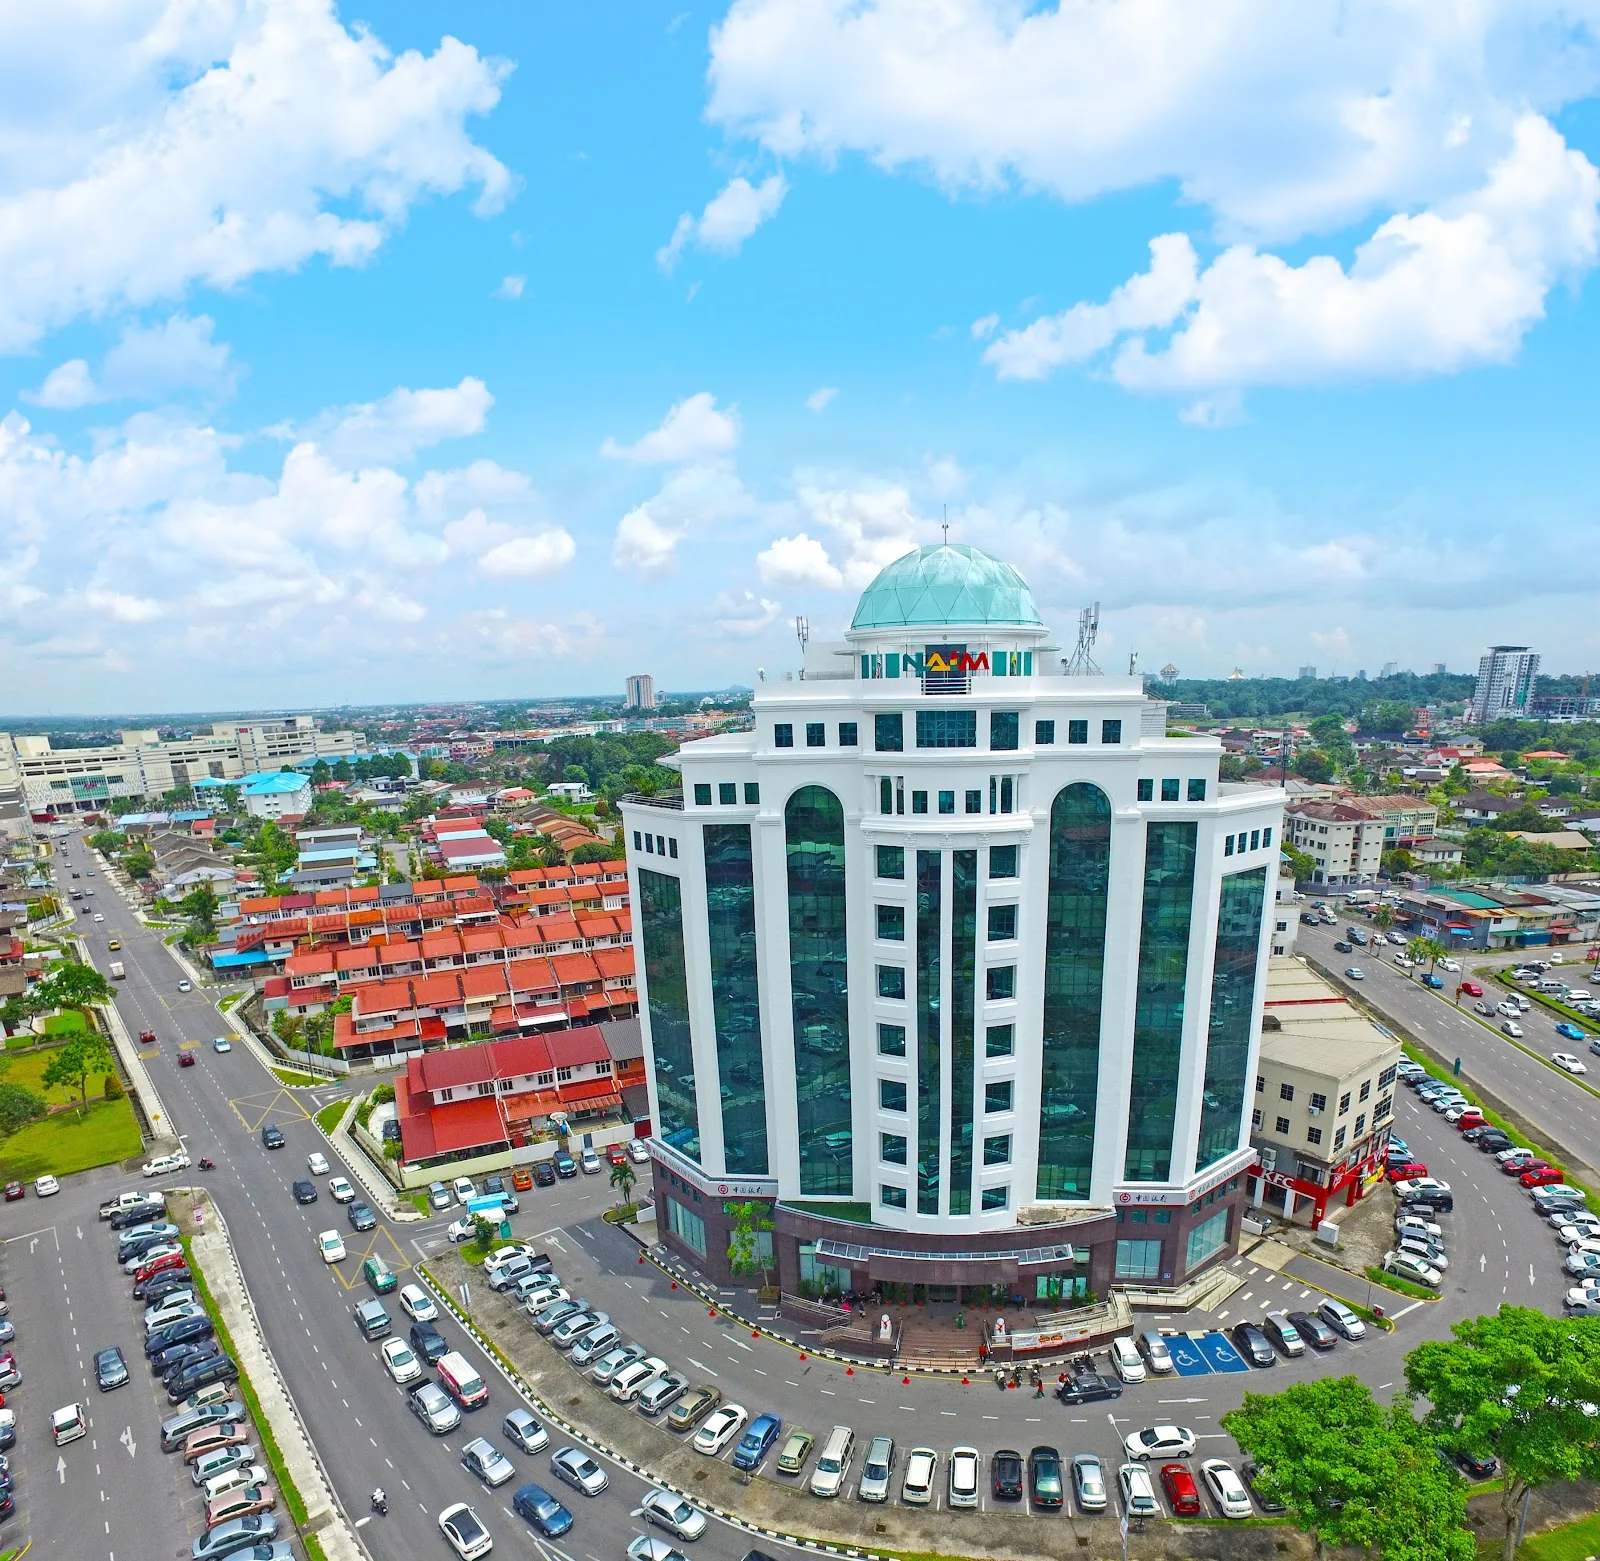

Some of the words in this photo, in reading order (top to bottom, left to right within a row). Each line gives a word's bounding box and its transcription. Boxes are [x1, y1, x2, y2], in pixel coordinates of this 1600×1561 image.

[903, 652, 989, 671] NAIM
[1373, 1147, 1386, 1162] KFC
[1260, 1169, 1295, 1188] KFC
